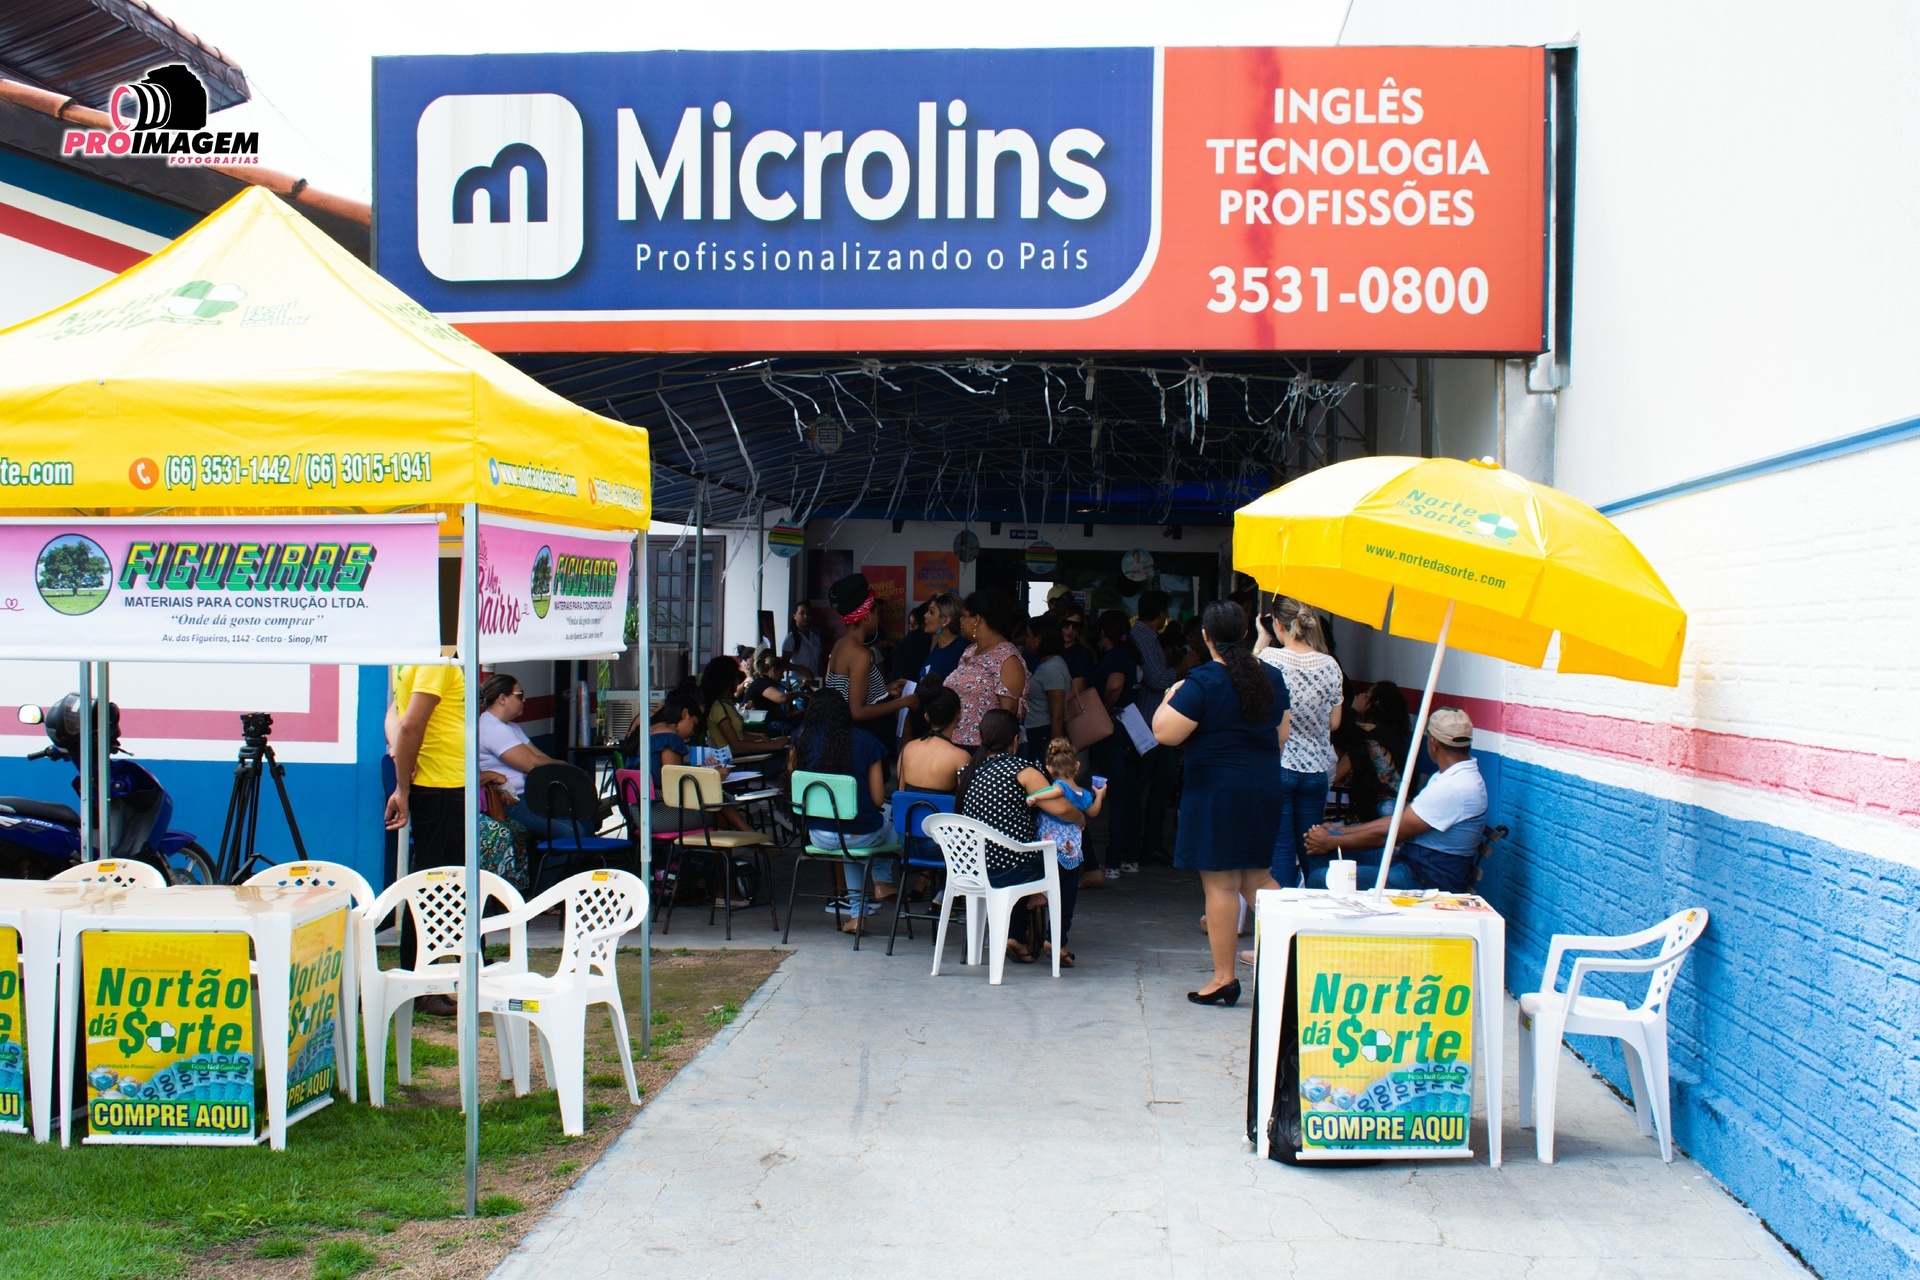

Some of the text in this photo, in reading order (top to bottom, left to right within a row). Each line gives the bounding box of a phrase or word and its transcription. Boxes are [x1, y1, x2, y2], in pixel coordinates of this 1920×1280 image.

[1273, 77, 1425, 126] INGLÊS
[616, 98, 1108, 222] Microlins
[1205, 138, 1490, 177] TECNOLOGIA
[1219, 180, 1476, 227] PROFISSÕES
[635, 240, 1090, 273] Profissionalizando o País
[1206, 265, 1490, 315] 3531-0800
[164, 455, 197, 490] (66)
[201, 454, 291, 485] 3531-1442
[304, 453, 337, 489] (66)
[341, 452, 431, 483] 3015-1941
[1396, 499, 1412, 509] da
[1406, 489, 1478, 517] Norte
[1409, 504, 1472, 528] Sorte
[118, 541, 378, 592] FIGUEIRAS
[553, 553, 618, 598] FIGUEIRAS
[124, 595, 369, 611] MATERIAIS PARA CONSTRUÇÃO LTDA.
[212, 613, 228, 626] dá
[229, 615, 262, 628] gosto
[162, 634, 175, 643] Av.
[176, 634, 190, 643] das
[191, 633, 231, 645] Figueiras,
[232, 634, 251, 643] 1142
[256, 634, 283, 643] Centro
[288, 633, 329, 645] Sinop/MT
[96, 967, 249, 1009] Nortão
[1310, 973, 1471, 1016] Nortão
[88, 1012, 119, 1037] dá
[1302, 1020, 1332, 1046] dá
[306, 1067, 331, 1099] AQUI
[93, 1102, 249, 1131] COMPRE AQUI
[1306, 1114, 1464, 1144] COMPRE AQUI
